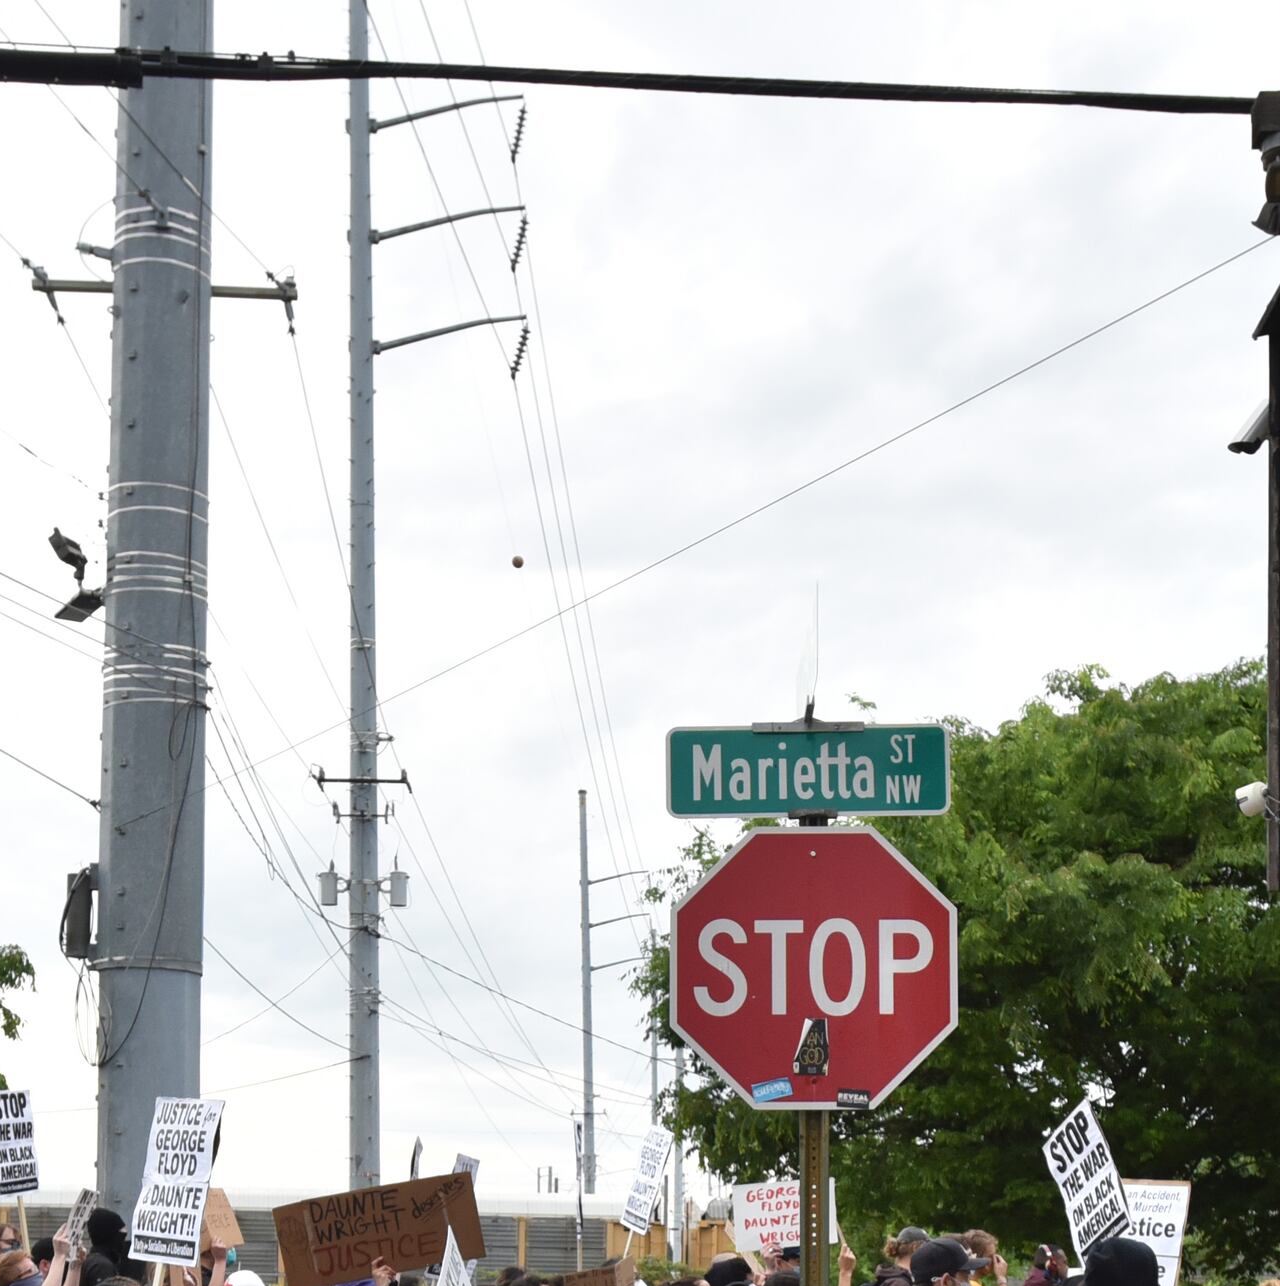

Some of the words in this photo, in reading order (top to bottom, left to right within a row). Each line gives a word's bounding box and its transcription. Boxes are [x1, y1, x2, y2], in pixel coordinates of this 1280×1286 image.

[692, 742, 875, 801] Marietta
[890, 734, 916, 764] ST
[885, 774, 922, 804] NW
[693, 918, 934, 1017] STOP
[157, 1102, 204, 1126] JUSTICE
[12, 1121, 33, 1140] WAR
[155, 1129, 207, 1153] GEORGE
[1050, 1110, 1090, 1174] STOP
[9, 1145, 35, 1162] BLACK
[158, 1152, 198, 1176] FLOYD
[0, 1162, 36, 1181] AMERICA!
[1062, 1167, 1084, 1202] THE
[1081, 1142, 1109, 1181] WAR
[151, 1184, 203, 1210] DAUNTE
[309, 1189, 400, 1224] DAUNTE
[746, 1186, 800, 1203] GEORG
[761, 1199, 800, 1212] FLOYD
[1073, 1204, 1085, 1227] ON
[1083, 1173, 1115, 1217] BLACK
[1140, 1190, 1181, 1201] Accident,
[1133, 1202, 1173, 1213] Murder!
[137, 1208, 197, 1237] WRIGHT!!
[314, 1208, 406, 1244] WRIGHT
[744, 1213, 799, 1230] DAUNTE
[1078, 1194, 1121, 1249] AMERICA!
[1128, 1217, 1176, 1238] stice
[760, 1230, 800, 1244] WRIGH
[312, 1231, 441, 1277] JUSTICE
